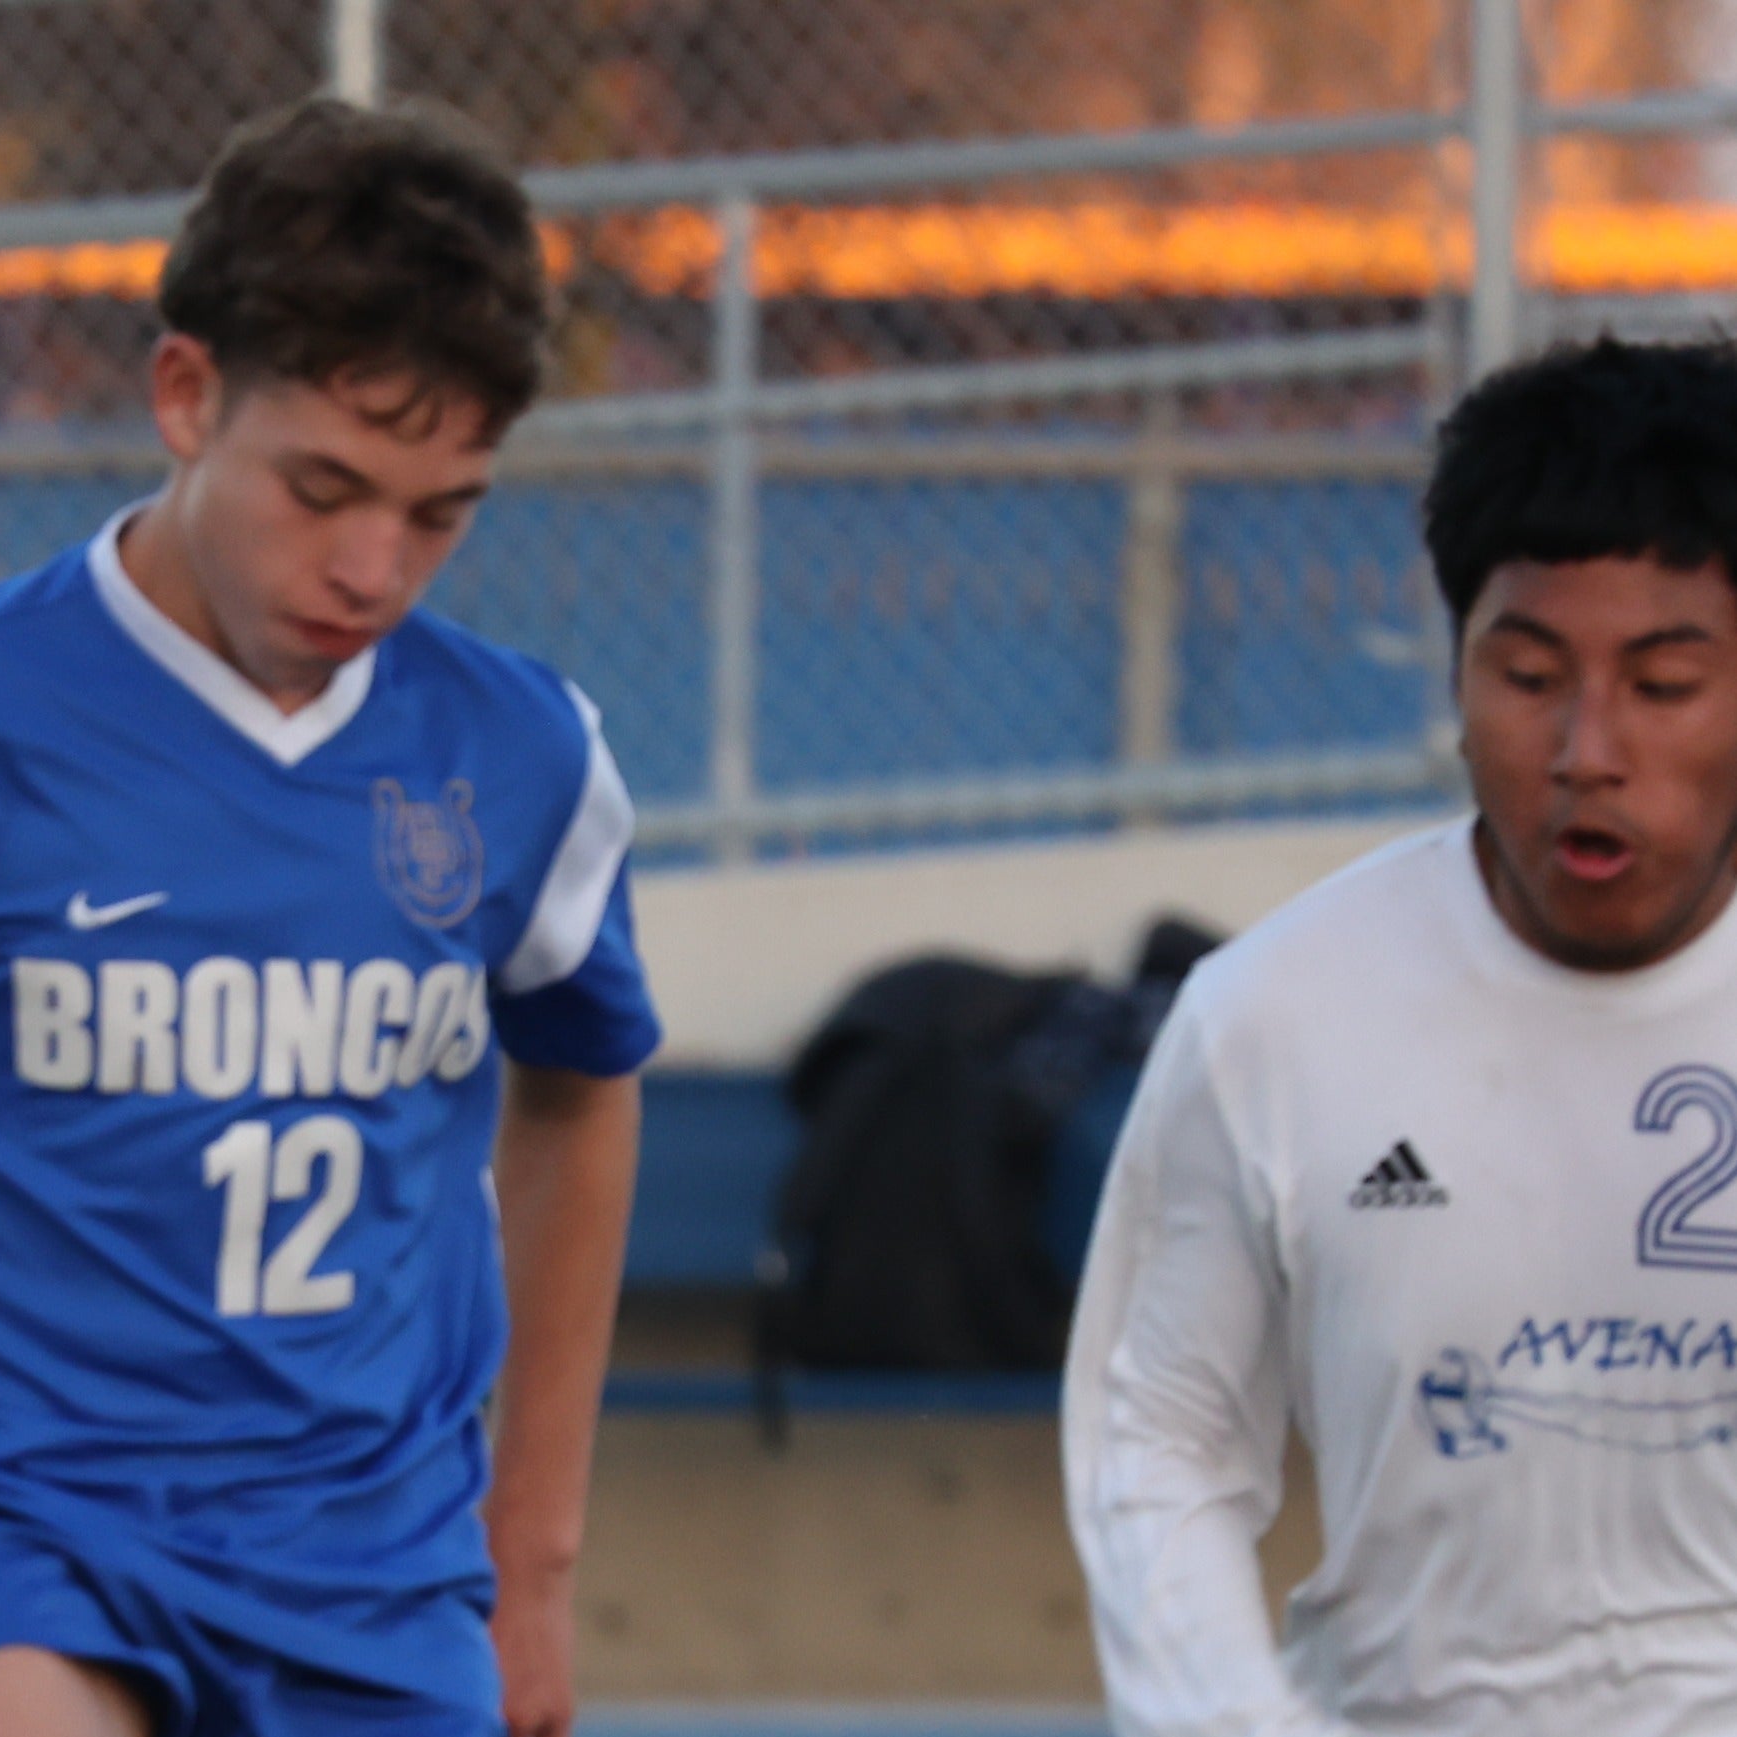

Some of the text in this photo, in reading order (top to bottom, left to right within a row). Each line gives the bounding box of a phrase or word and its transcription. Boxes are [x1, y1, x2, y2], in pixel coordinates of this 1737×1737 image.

[11, 956, 490, 1099] BRONCOS
[202, 1114, 361, 1317] 12
[1634, 1063, 1737, 1273] 2
[1496, 1317, 1737, 1370] AVENA
